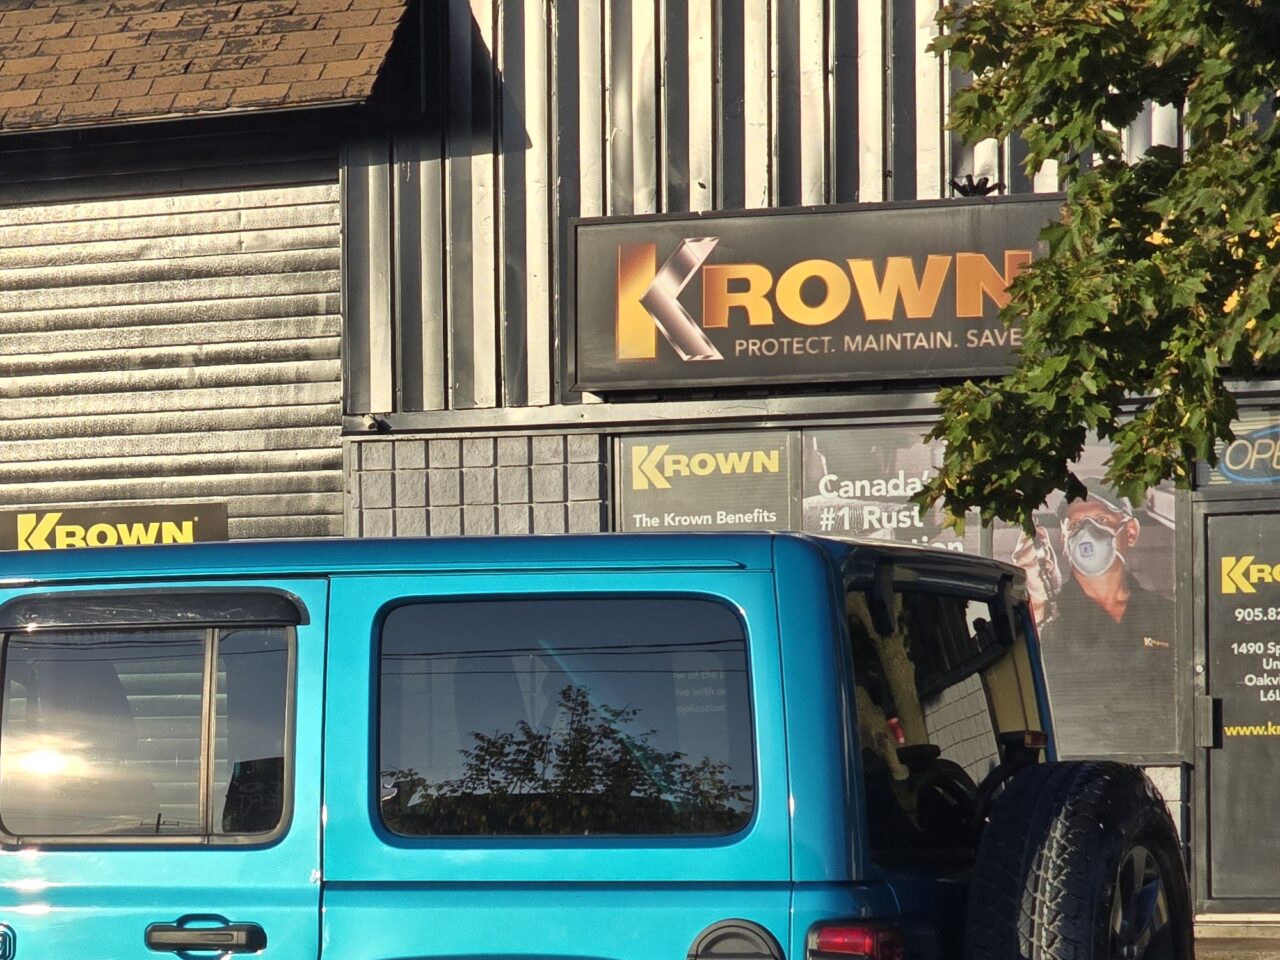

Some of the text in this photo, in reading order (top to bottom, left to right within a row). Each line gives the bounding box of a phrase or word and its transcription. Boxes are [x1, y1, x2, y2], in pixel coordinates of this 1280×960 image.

[616, 236, 1034, 363] KROWN
[734, 335, 836, 358] PROTECT.
[843, 331, 959, 353] MAINTAIN.
[631, 444, 780, 491] KROWN
[632, 510, 777, 528] The Krown Benefits
[819, 502, 924, 531] #1 Rust
[17, 512, 194, 550] KROWN
[1231, 642, 1264, 655] 1490
[1262, 657, 1280, 670] Un
[1260, 689, 1280, 702] L6L
